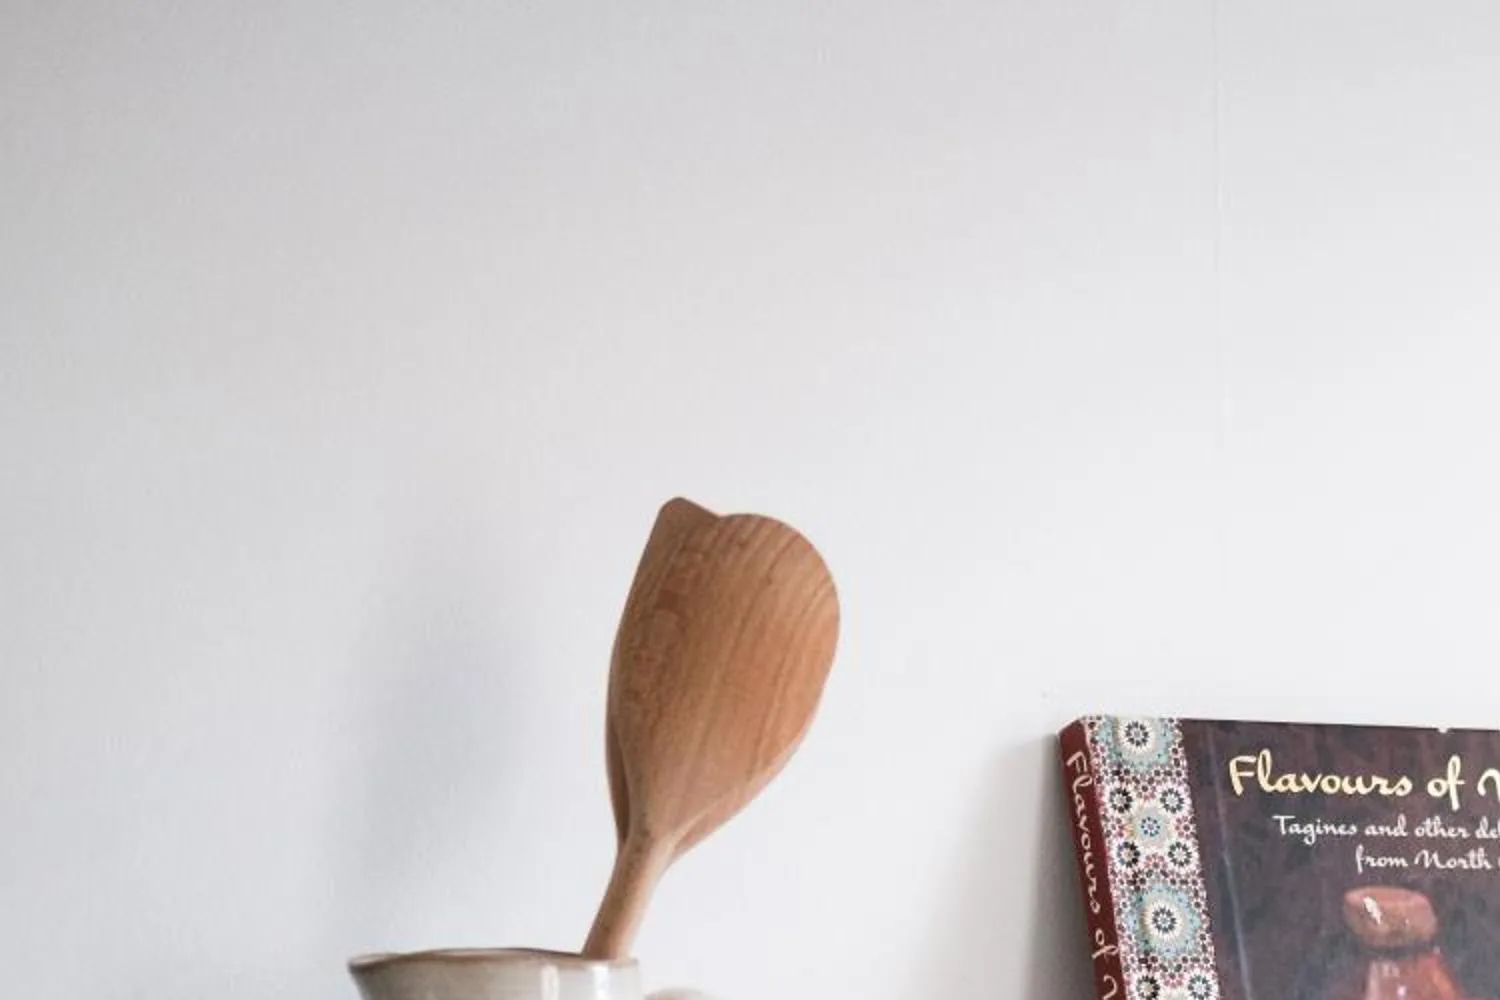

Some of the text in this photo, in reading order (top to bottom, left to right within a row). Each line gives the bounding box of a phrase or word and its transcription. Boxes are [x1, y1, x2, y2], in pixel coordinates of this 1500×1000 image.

[1229, 749, 1413, 797] Flavours
[1427, 755, 1464, 811] of
[1272, 814, 1358, 845] Tagines
[1364, 815, 1407, 837] and
[1414, 817, 1470, 839] other
[1066, 750, 1101, 916] Flavours
[1091, 928, 1119, 960] of
[1355, 846, 1408, 874] from
[1414, 849, 1492, 871] North
